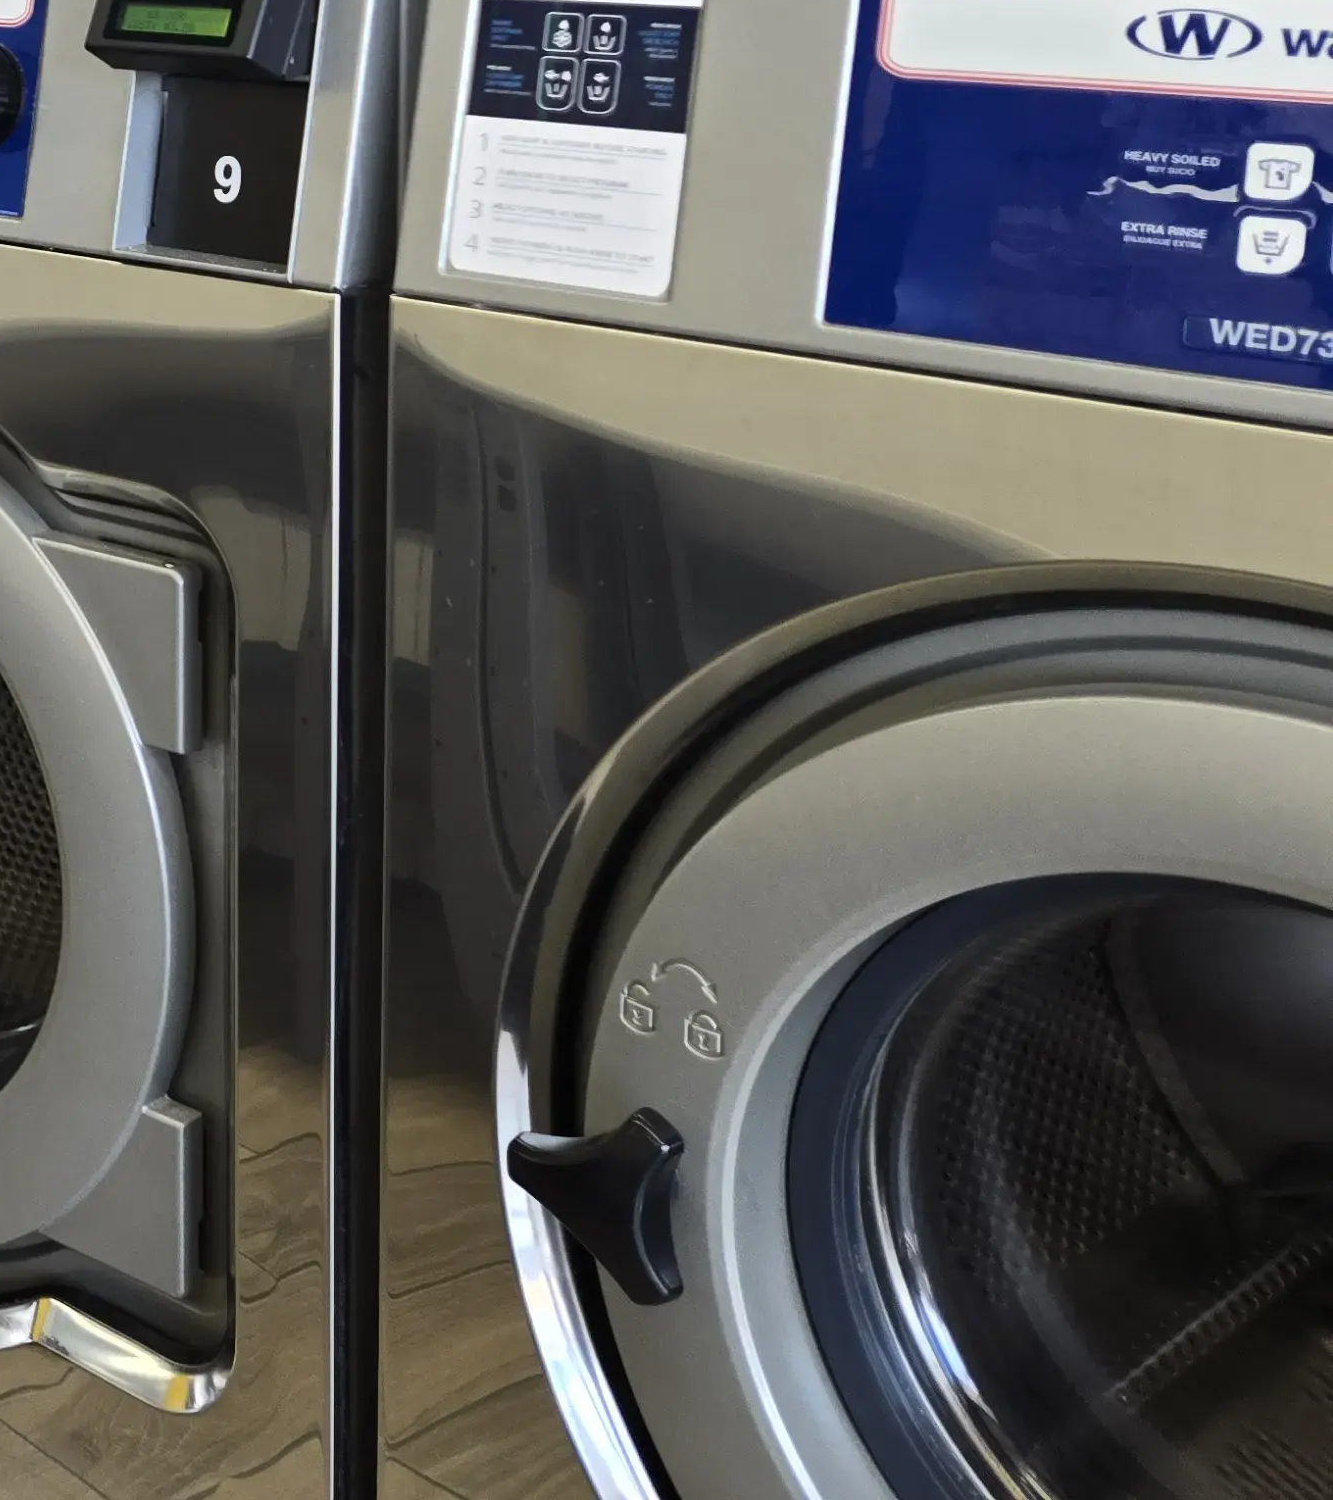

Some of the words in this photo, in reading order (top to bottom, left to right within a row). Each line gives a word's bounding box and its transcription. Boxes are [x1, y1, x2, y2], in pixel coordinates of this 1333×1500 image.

[1124, 150, 1169, 163] HEAVY
[1171, 154, 1221, 167] SOILED
[213, 155, 242, 204] 9
[1121, 221, 1164, 235] EXTRA
[1168, 225, 1208, 239] RINSE
